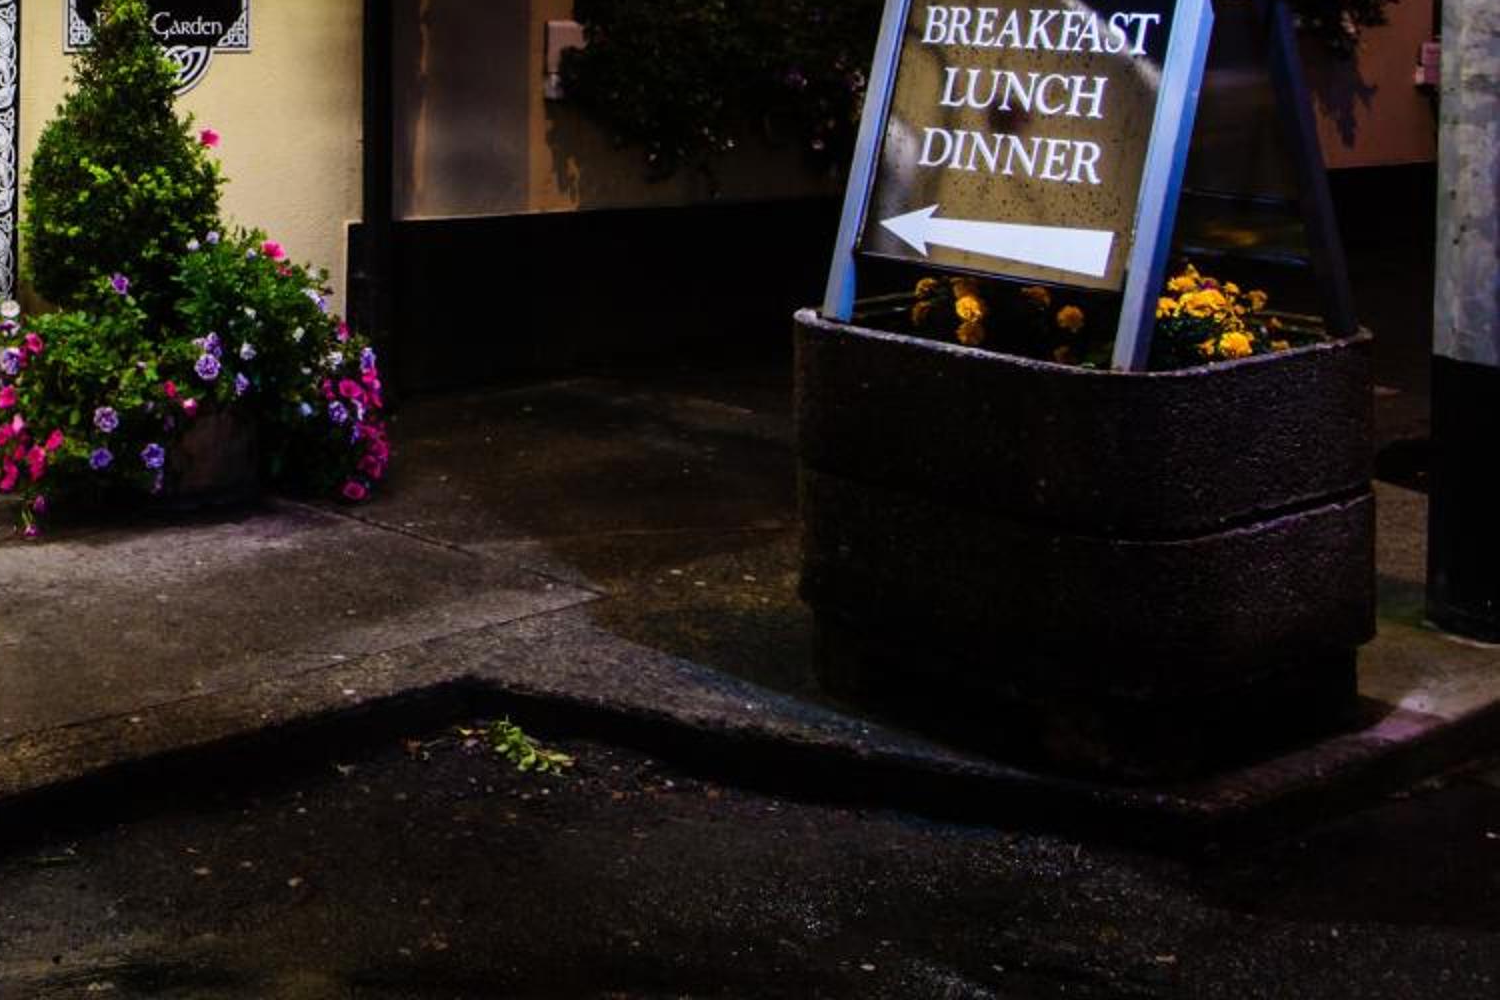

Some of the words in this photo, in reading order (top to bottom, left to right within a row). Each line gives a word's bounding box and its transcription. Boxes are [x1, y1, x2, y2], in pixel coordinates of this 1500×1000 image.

[150, 12, 223, 40] Garden
[921, 6, 1161, 55] BREAKFAST
[940, 67, 1108, 119] LUNCH
[918, 128, 1103, 185] DINNER
